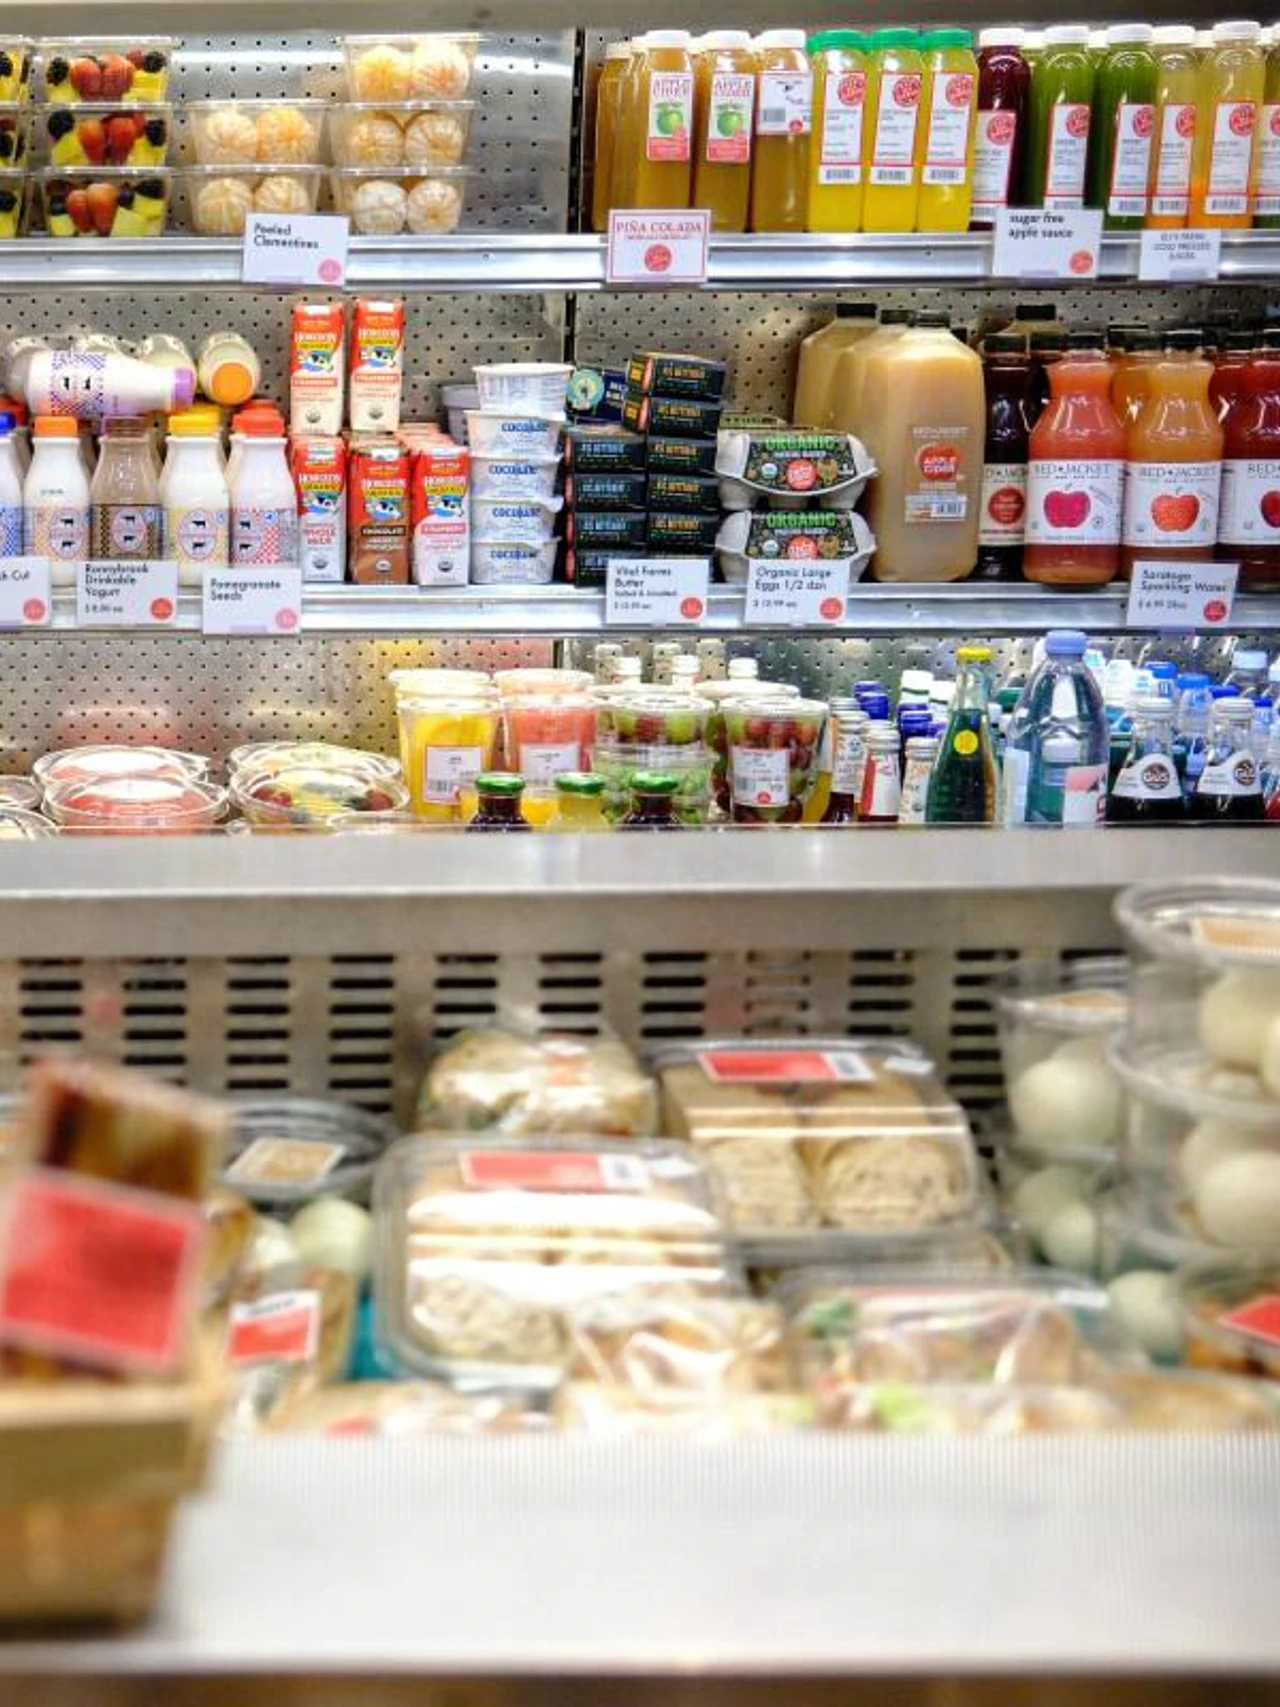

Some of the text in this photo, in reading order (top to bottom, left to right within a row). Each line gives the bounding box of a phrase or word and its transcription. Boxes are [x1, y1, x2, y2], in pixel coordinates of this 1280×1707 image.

[1009, 212, 1064, 227] sugar free
[1008, 227, 1075, 242] apple sauce
[1247, 462, 1277, 474] RED
[756, 566, 832, 580] Organic Large
[615, 577, 645, 588] Butter
[755, 578, 780, 592] Eggs
[785, 580, 804, 592] 1/2
[210, 589, 242, 601] Seeds
